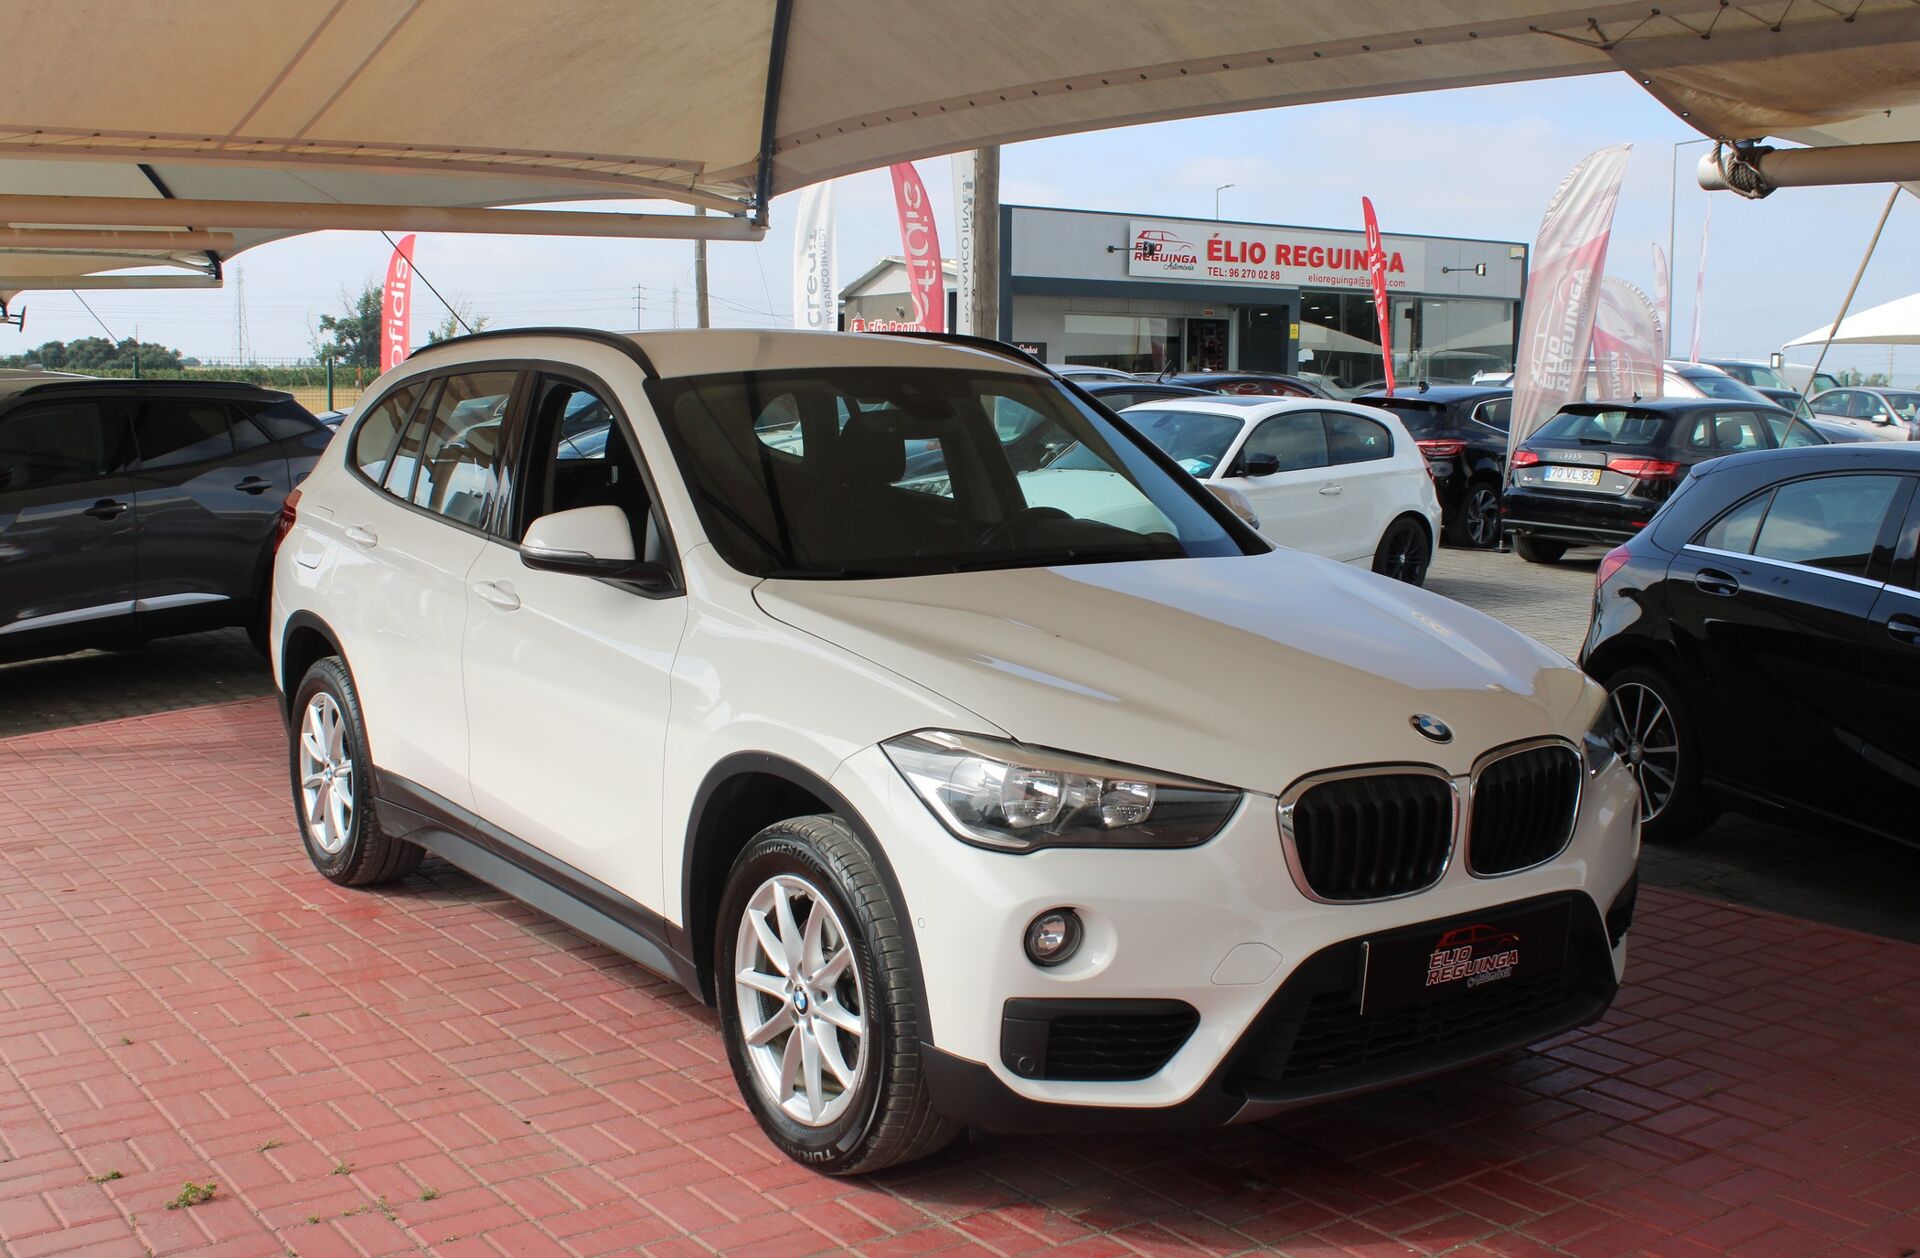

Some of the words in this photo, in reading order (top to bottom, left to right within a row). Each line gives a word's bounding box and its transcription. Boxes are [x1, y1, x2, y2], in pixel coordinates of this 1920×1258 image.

[1134, 251, 1197, 264] REGUINGA
[1207, 232, 1266, 264] ÉLIO
[821, 270, 833, 307] BANCO
[1207, 266, 1227, 277] TEL:
[1229, 268, 1239, 278] 96
[1241, 269, 1256, 279] 270
[1258, 270, 1268, 280] 02
[1270, 271, 1280, 280] 88
[388, 257, 408, 368] ofidis
[1555, 268, 1587, 393] REGUINGA
[1425, 950, 1520, 987] REGUINGA
